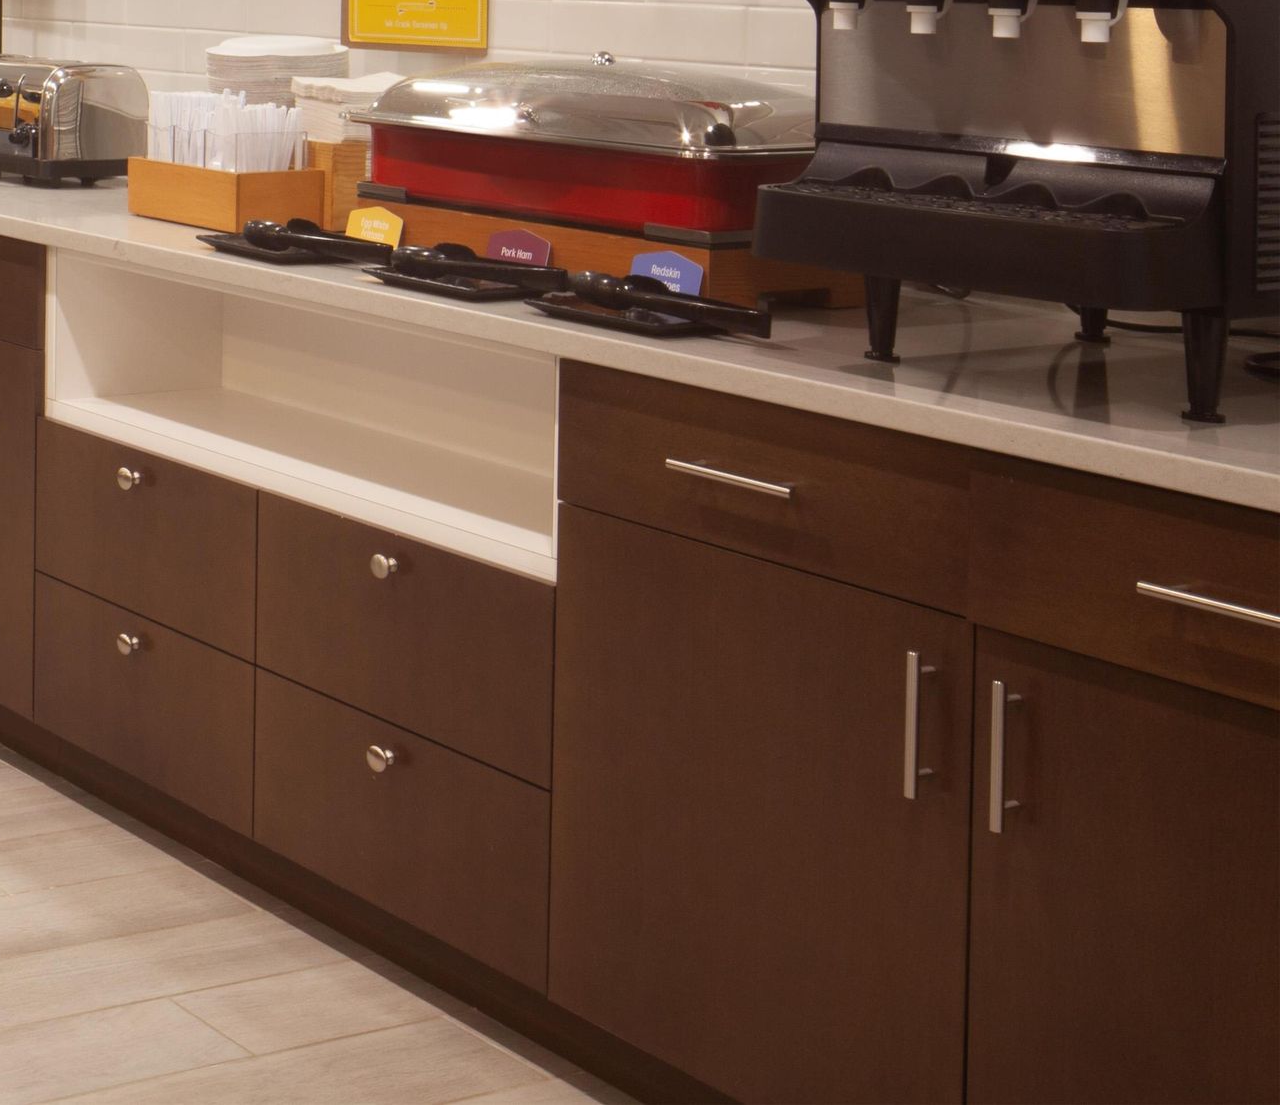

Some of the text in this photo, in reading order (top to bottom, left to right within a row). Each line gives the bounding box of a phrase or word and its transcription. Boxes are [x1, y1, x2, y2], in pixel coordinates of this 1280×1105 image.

[501, 246, 533, 261] Pork Ham
[651, 263, 680, 279] Redskin
